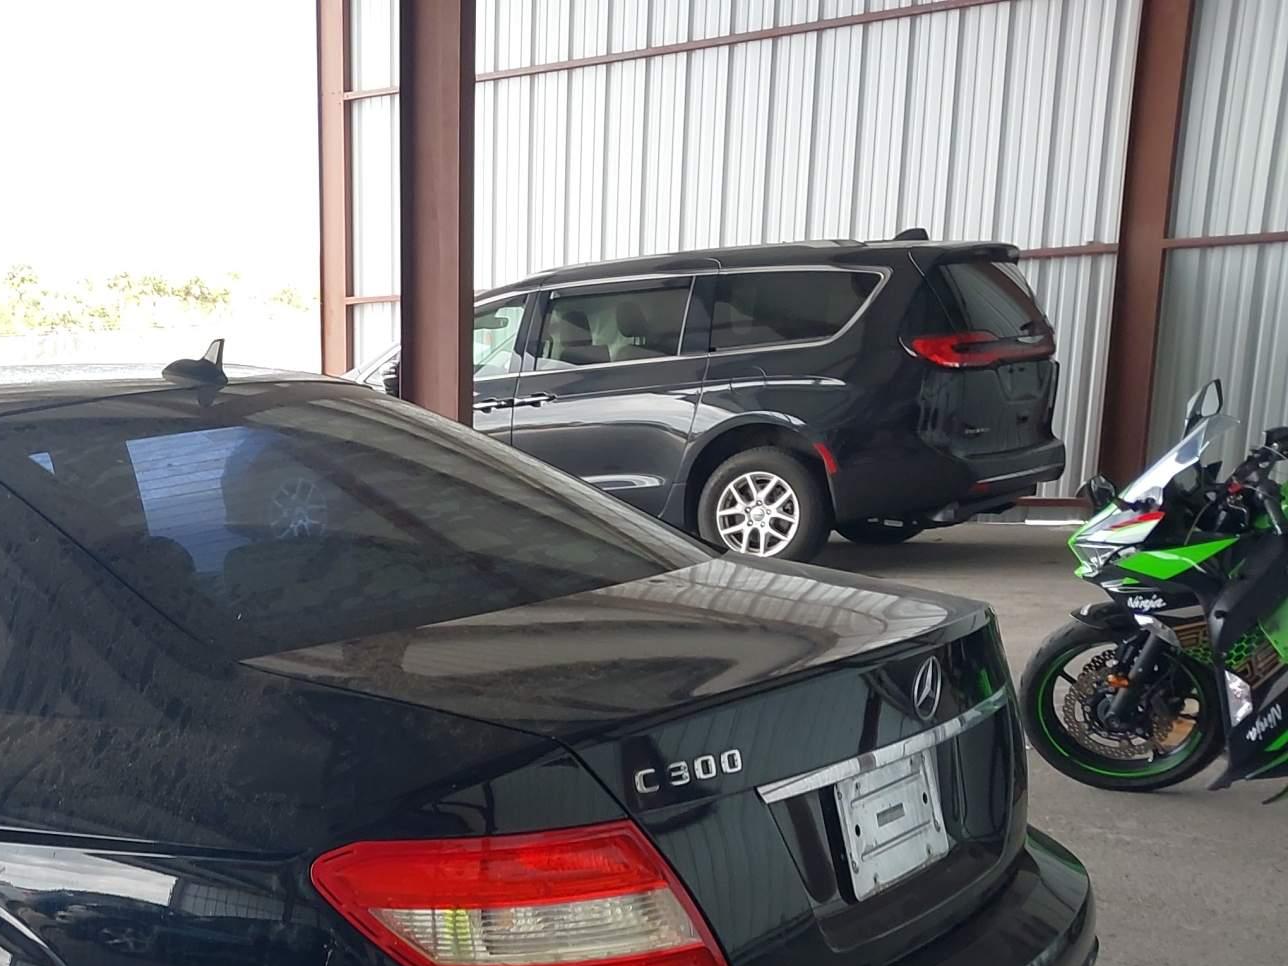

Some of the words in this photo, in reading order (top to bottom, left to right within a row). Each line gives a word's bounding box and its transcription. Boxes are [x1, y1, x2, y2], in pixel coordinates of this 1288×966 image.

[1127, 593, 1167, 613] Ninja
[1245, 703, 1282, 741] Ninja
[633, 767, 661, 794] C
[668, 748, 743, 787] 300
